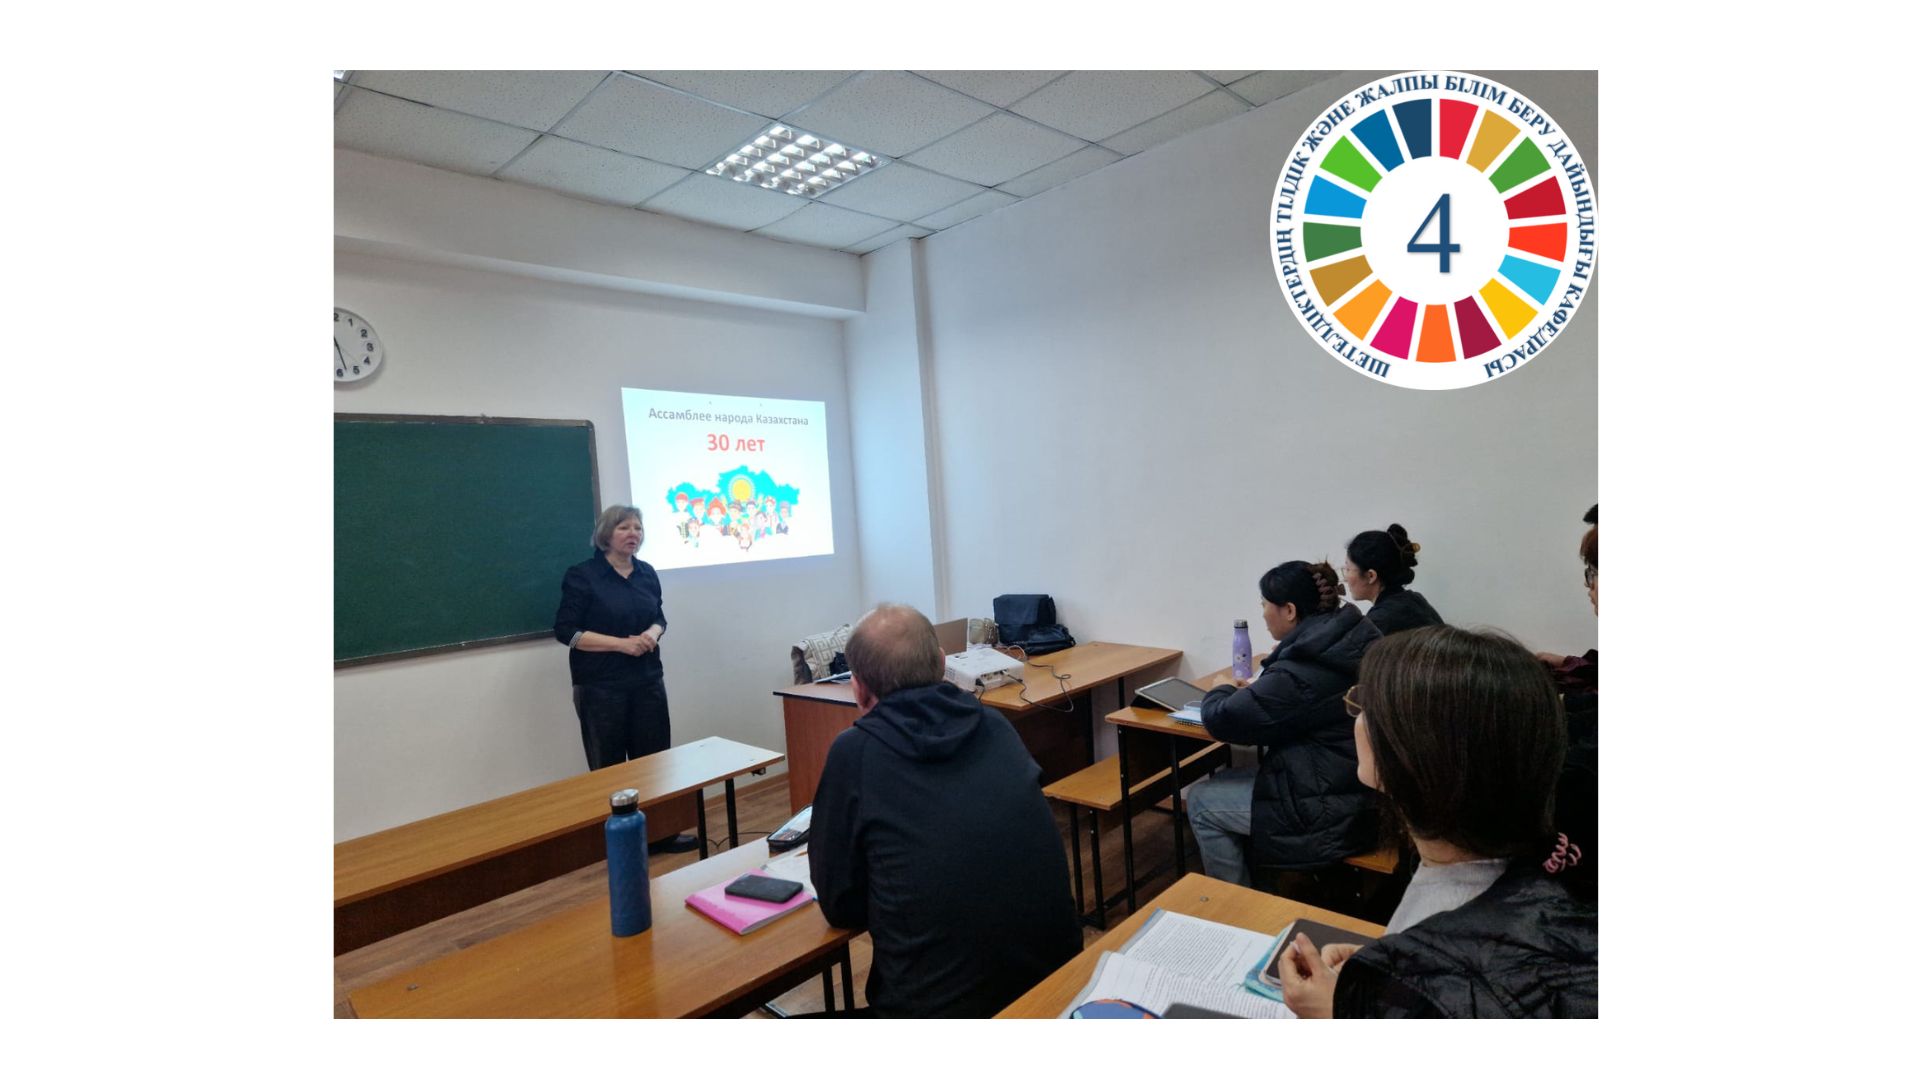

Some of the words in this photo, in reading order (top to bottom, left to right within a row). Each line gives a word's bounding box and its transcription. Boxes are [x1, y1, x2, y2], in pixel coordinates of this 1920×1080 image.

[348, 318, 353, 327] 1
[360, 328, 368, 338] 2
[366, 342, 374, 352] 3
[363, 356, 371, 365] 4
[336, 368, 344, 378] 6
[353, 365, 360, 375] 5
[648, 407, 712, 422] Ассамблее
[714, 413, 754, 425] народа
[756, 413, 809, 426] Казахстана
[707, 433, 730, 452] 30
[735, 437, 766, 452] лет
